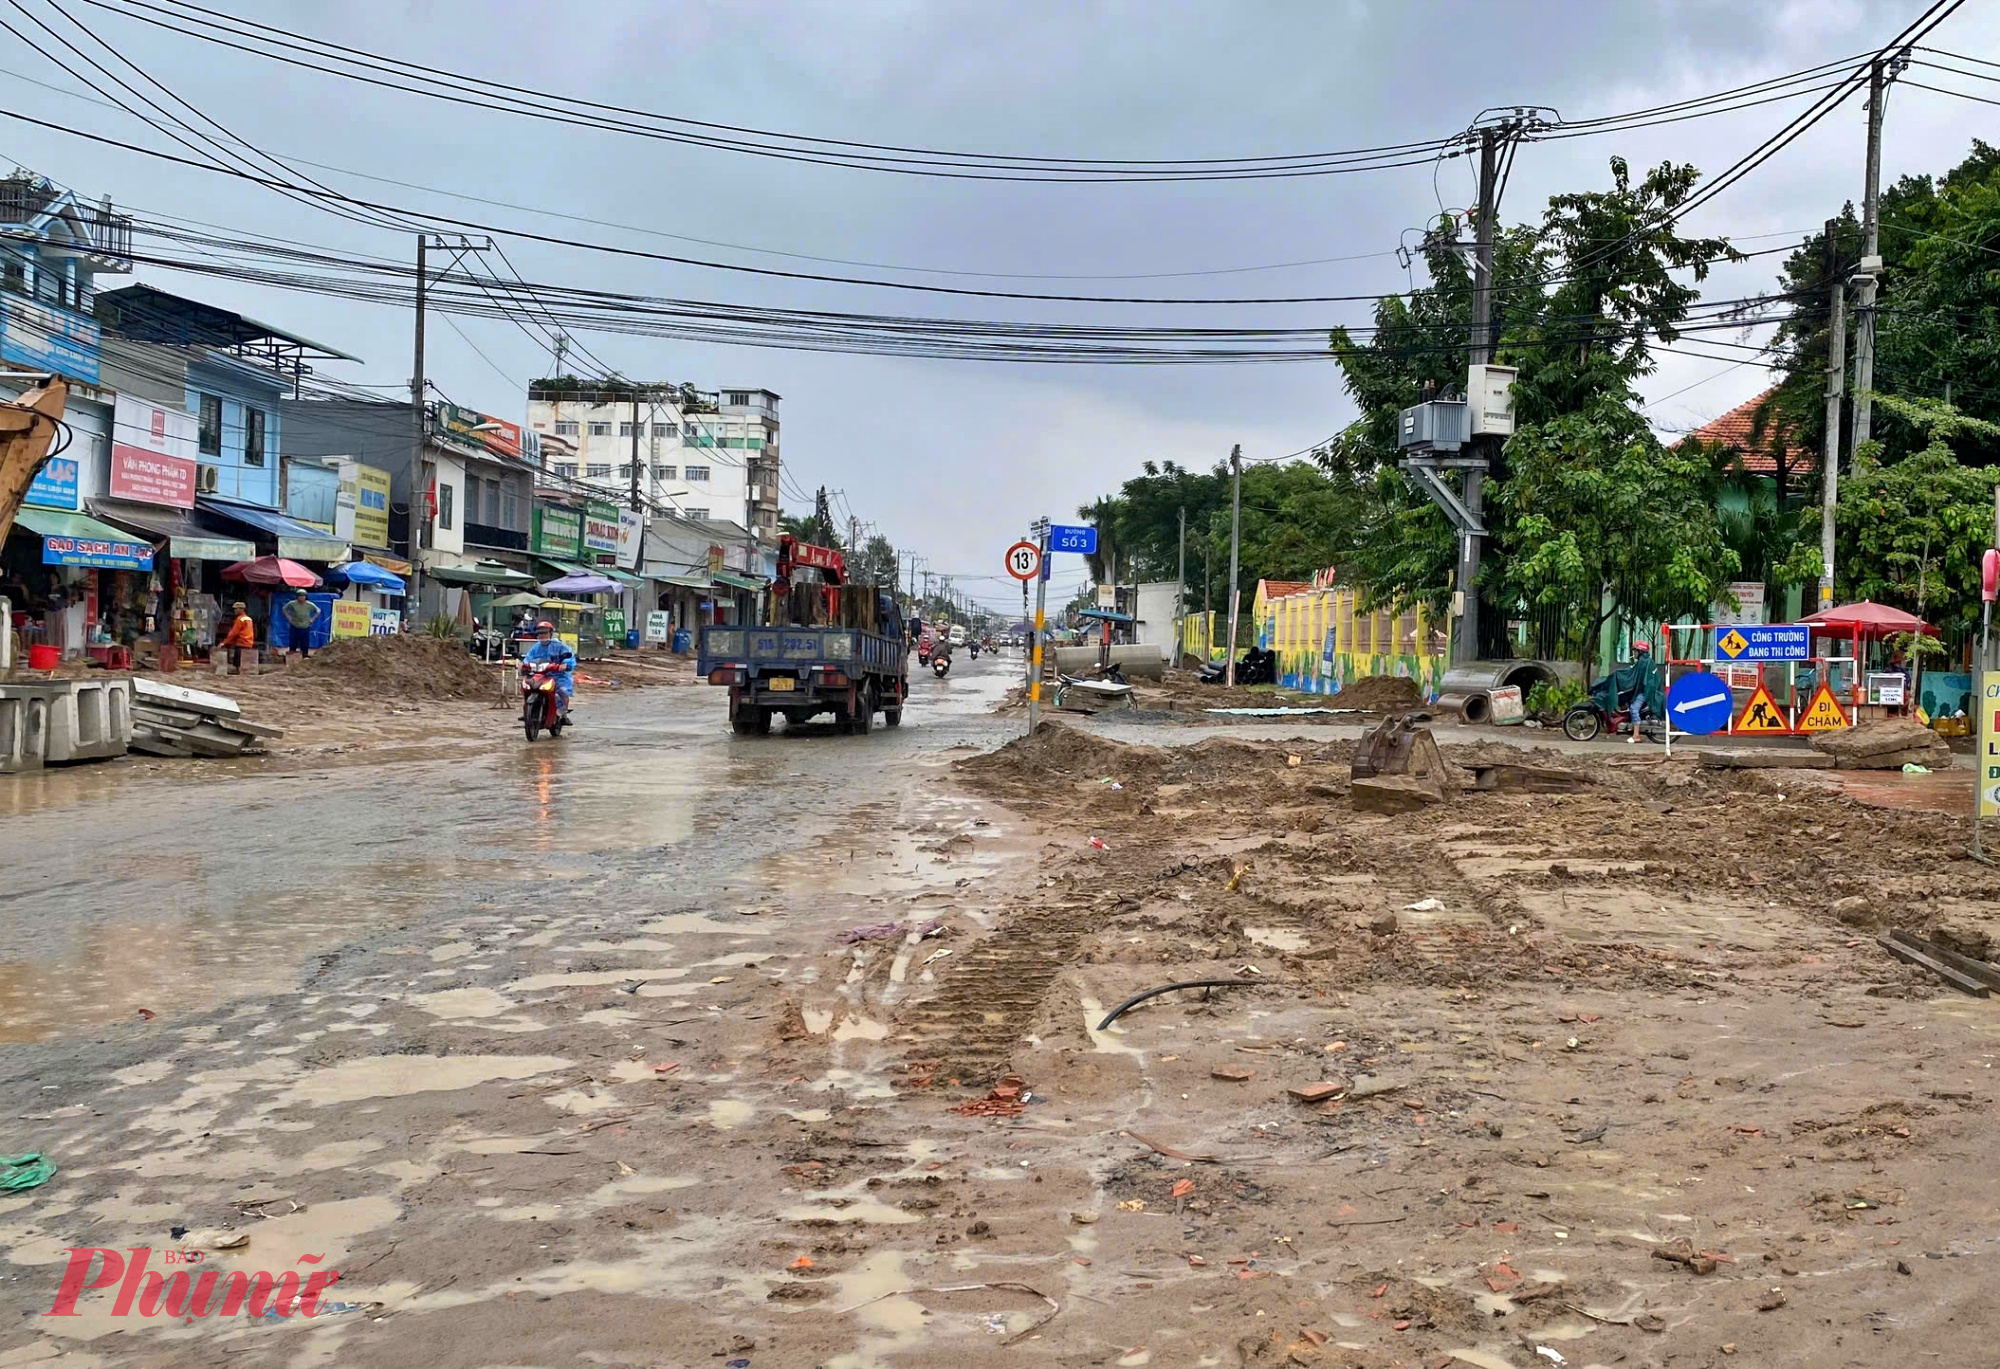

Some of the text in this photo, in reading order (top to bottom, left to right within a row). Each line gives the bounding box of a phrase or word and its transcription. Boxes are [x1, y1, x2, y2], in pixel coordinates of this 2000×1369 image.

[47, 537, 74, 554] GẠO
[77, 540, 111, 556] SẠCH
[112, 543, 130, 557] AN
[1062, 535, 1087, 548] SỐ 3
[605, 610, 624, 621] SỮA
[1751, 629, 1805, 642] CÔNG TRƯỜNG
[1748, 646, 1769, 657] ĐANG
[1784, 645, 1806, 657] CÔNG
[1819, 702, 1831, 713] ĐI
